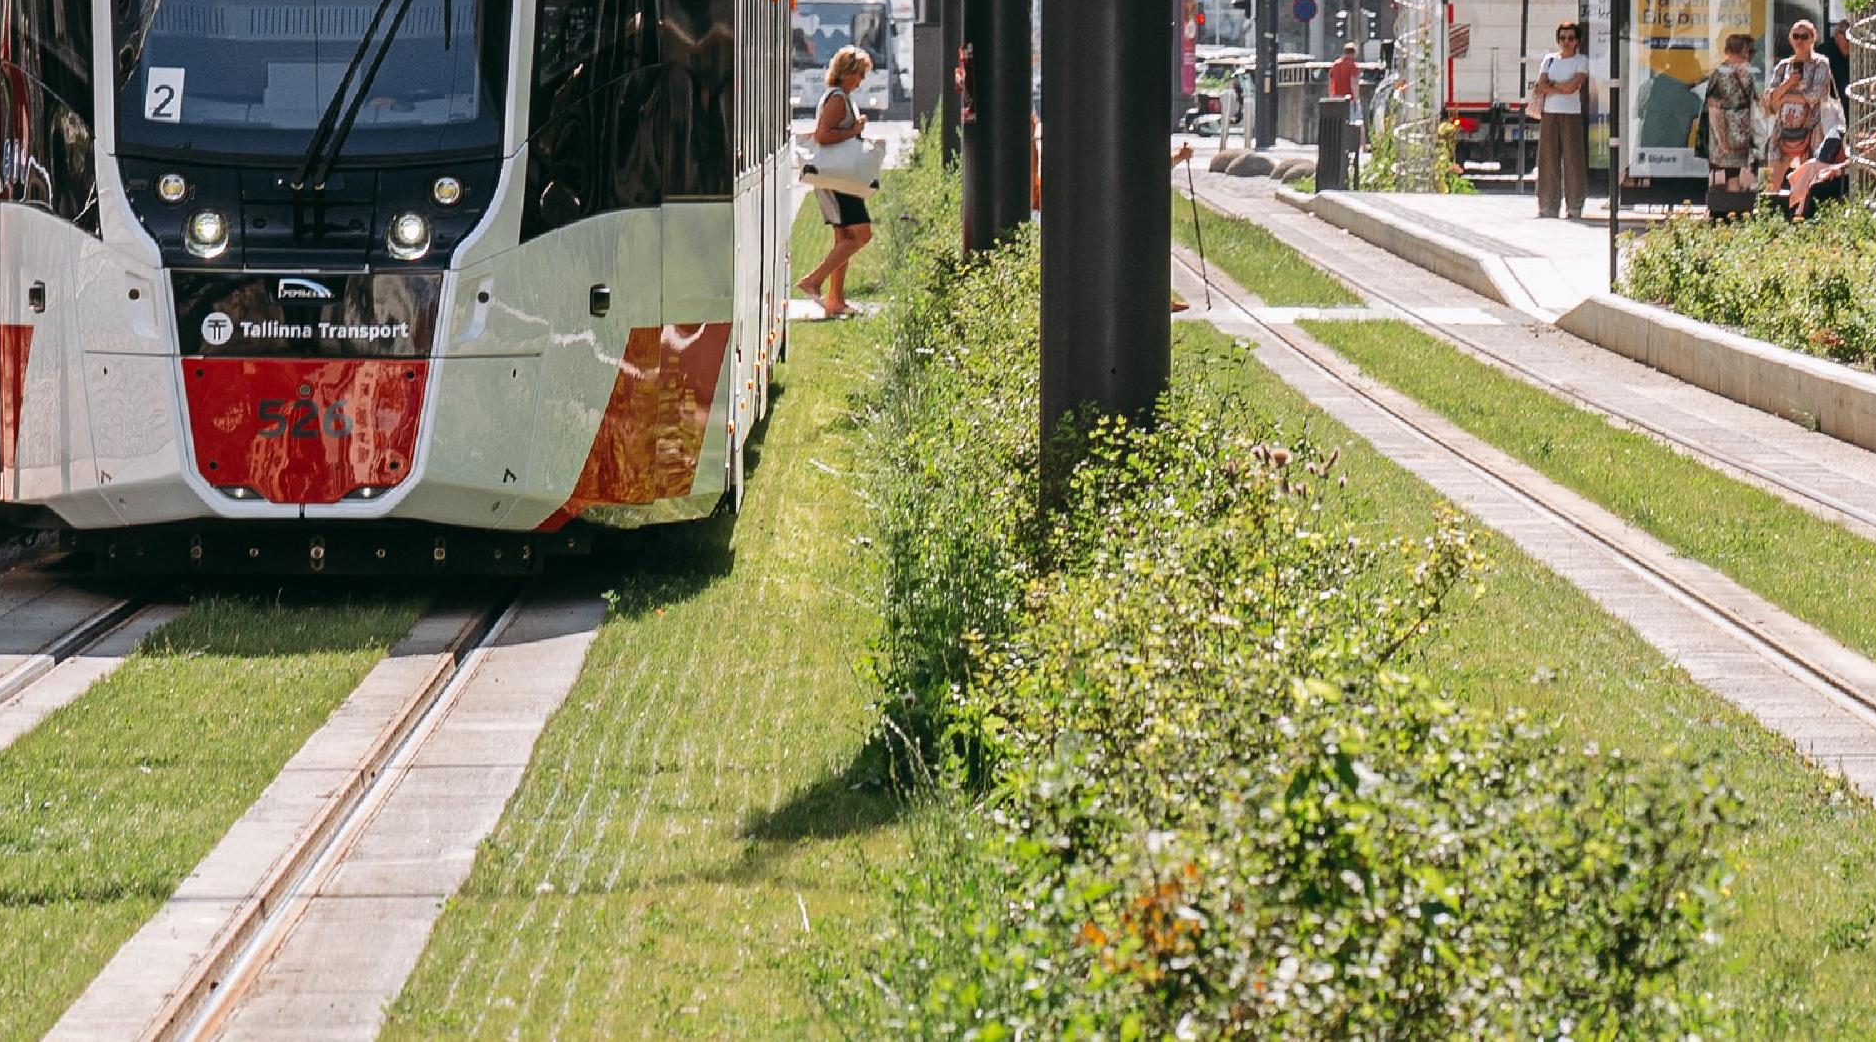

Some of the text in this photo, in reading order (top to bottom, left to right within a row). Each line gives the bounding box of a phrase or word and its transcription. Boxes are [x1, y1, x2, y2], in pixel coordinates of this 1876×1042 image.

[153, 84, 175, 118] 2
[240, 321, 409, 343] Tallinna Transport
[258, 399, 354, 439] 526
